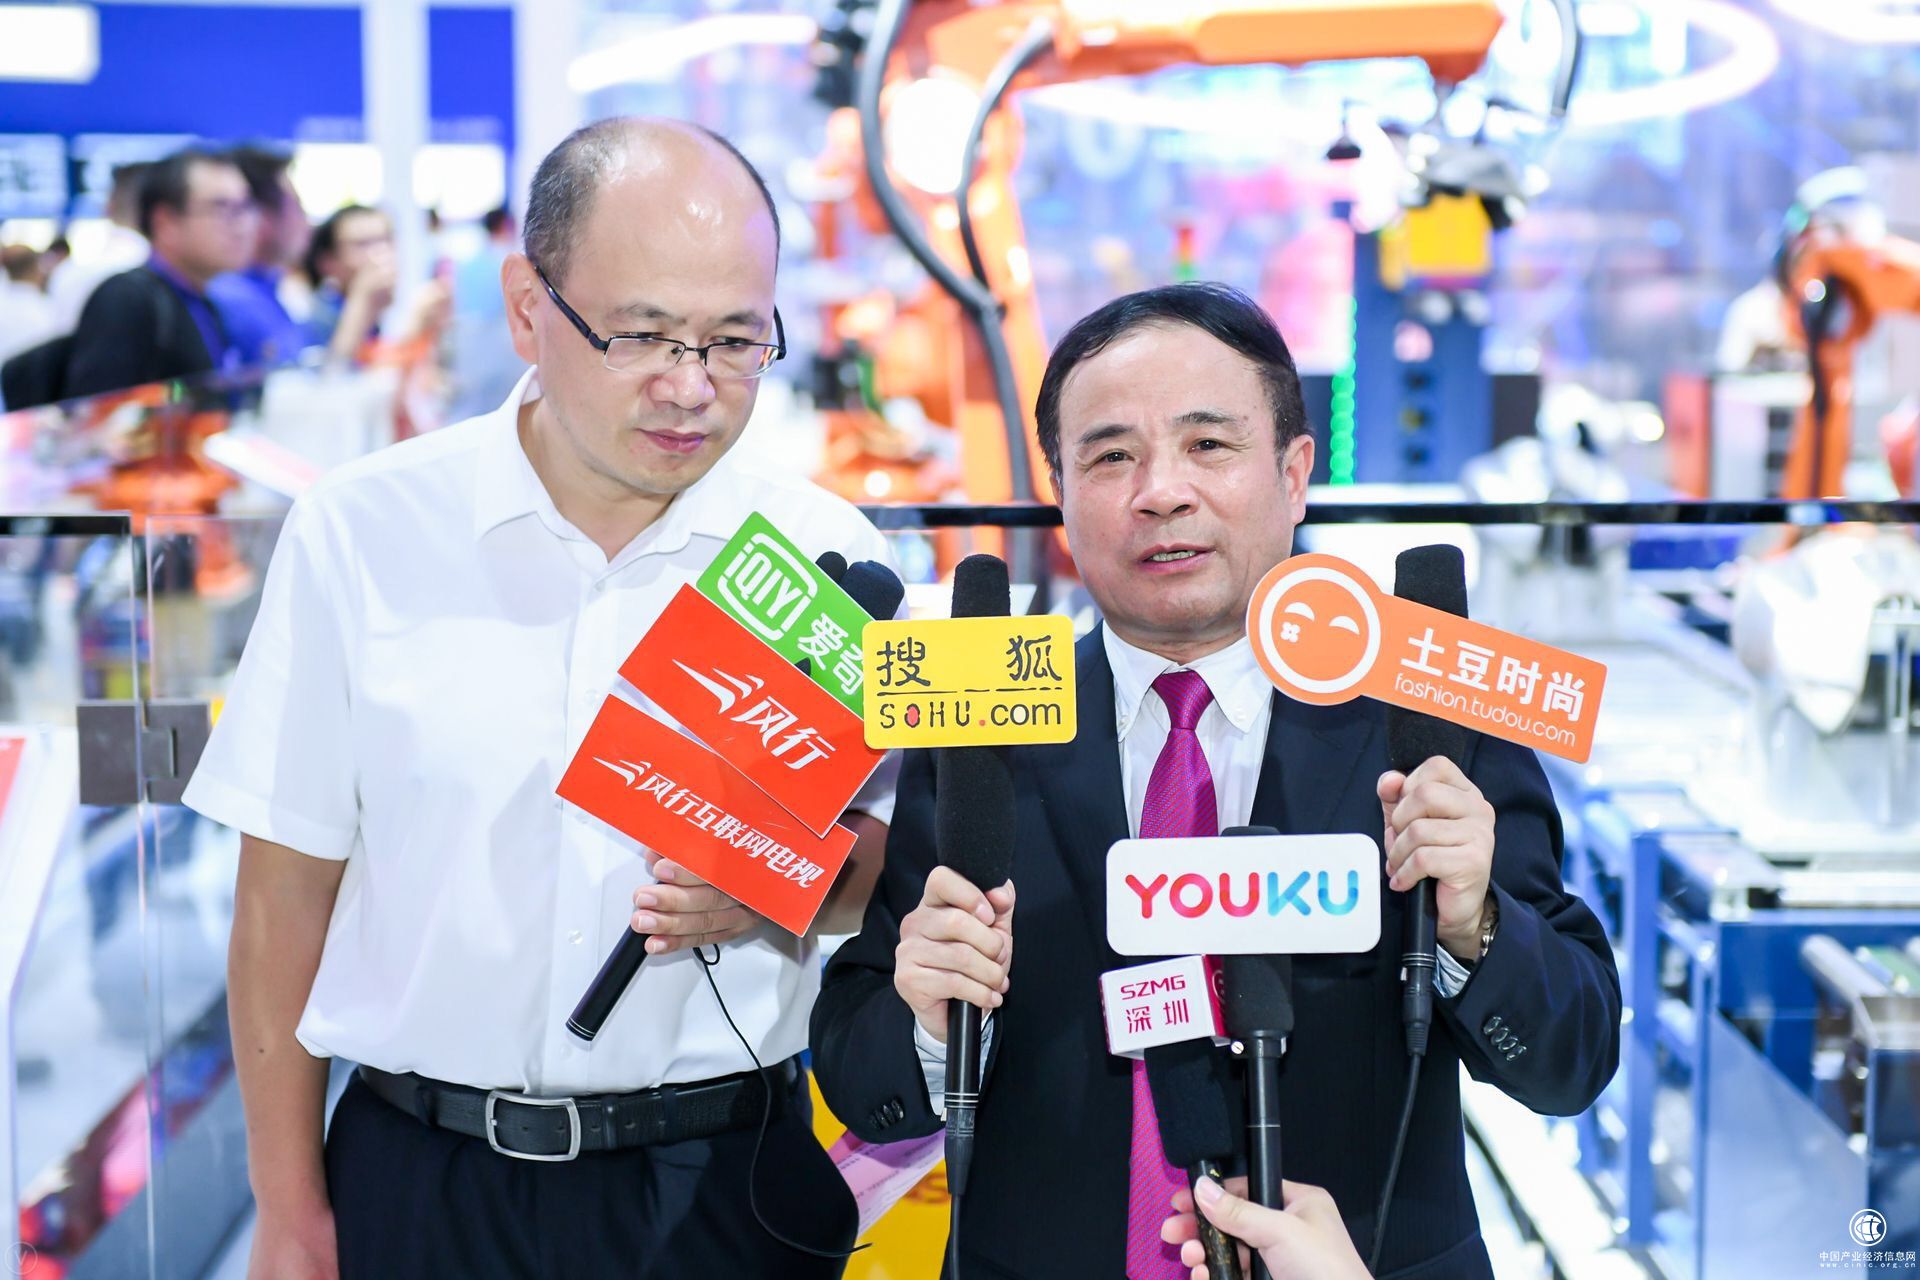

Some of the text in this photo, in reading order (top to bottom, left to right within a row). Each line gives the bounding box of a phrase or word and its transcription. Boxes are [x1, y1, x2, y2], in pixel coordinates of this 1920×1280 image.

[724, 541, 811, 632] iQIYI
[876, 634, 1062, 687] 搜狐
[1400, 627, 1586, 722] 土豆时尚
[731, 696, 836, 770] 风行
[879, 700, 1062, 729] SOHU.com
[1394, 672, 1576, 748] fashion.tudou.com
[636, 773, 825, 889] 风行互联网电视
[1125, 870, 1359, 919] YOUKU
[1120, 974, 1186, 1001] SZMG
[1125, 998, 1190, 1034] 深圳
